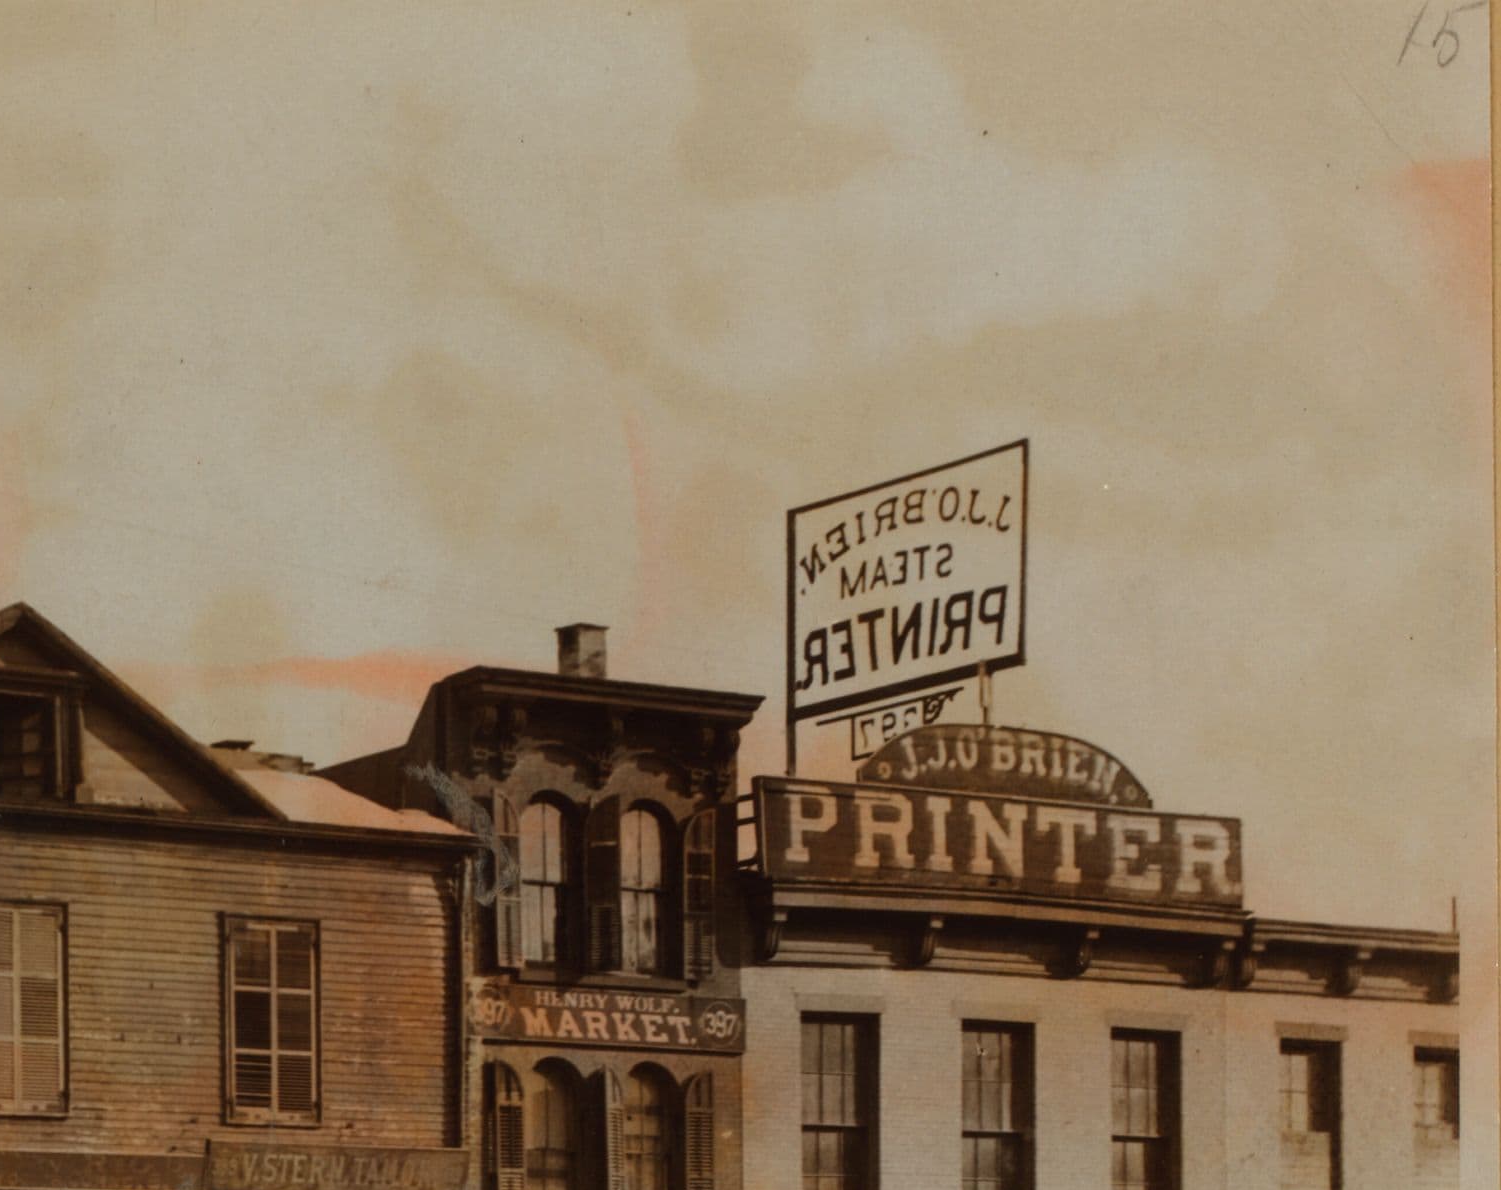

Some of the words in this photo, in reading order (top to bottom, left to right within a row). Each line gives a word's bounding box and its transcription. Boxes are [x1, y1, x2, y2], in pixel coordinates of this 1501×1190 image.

[1396, 0, 1489, 68] 15
[784, 792, 1241, 895] PRINTER
[520, 1007, 698, 1045] MARKET.
